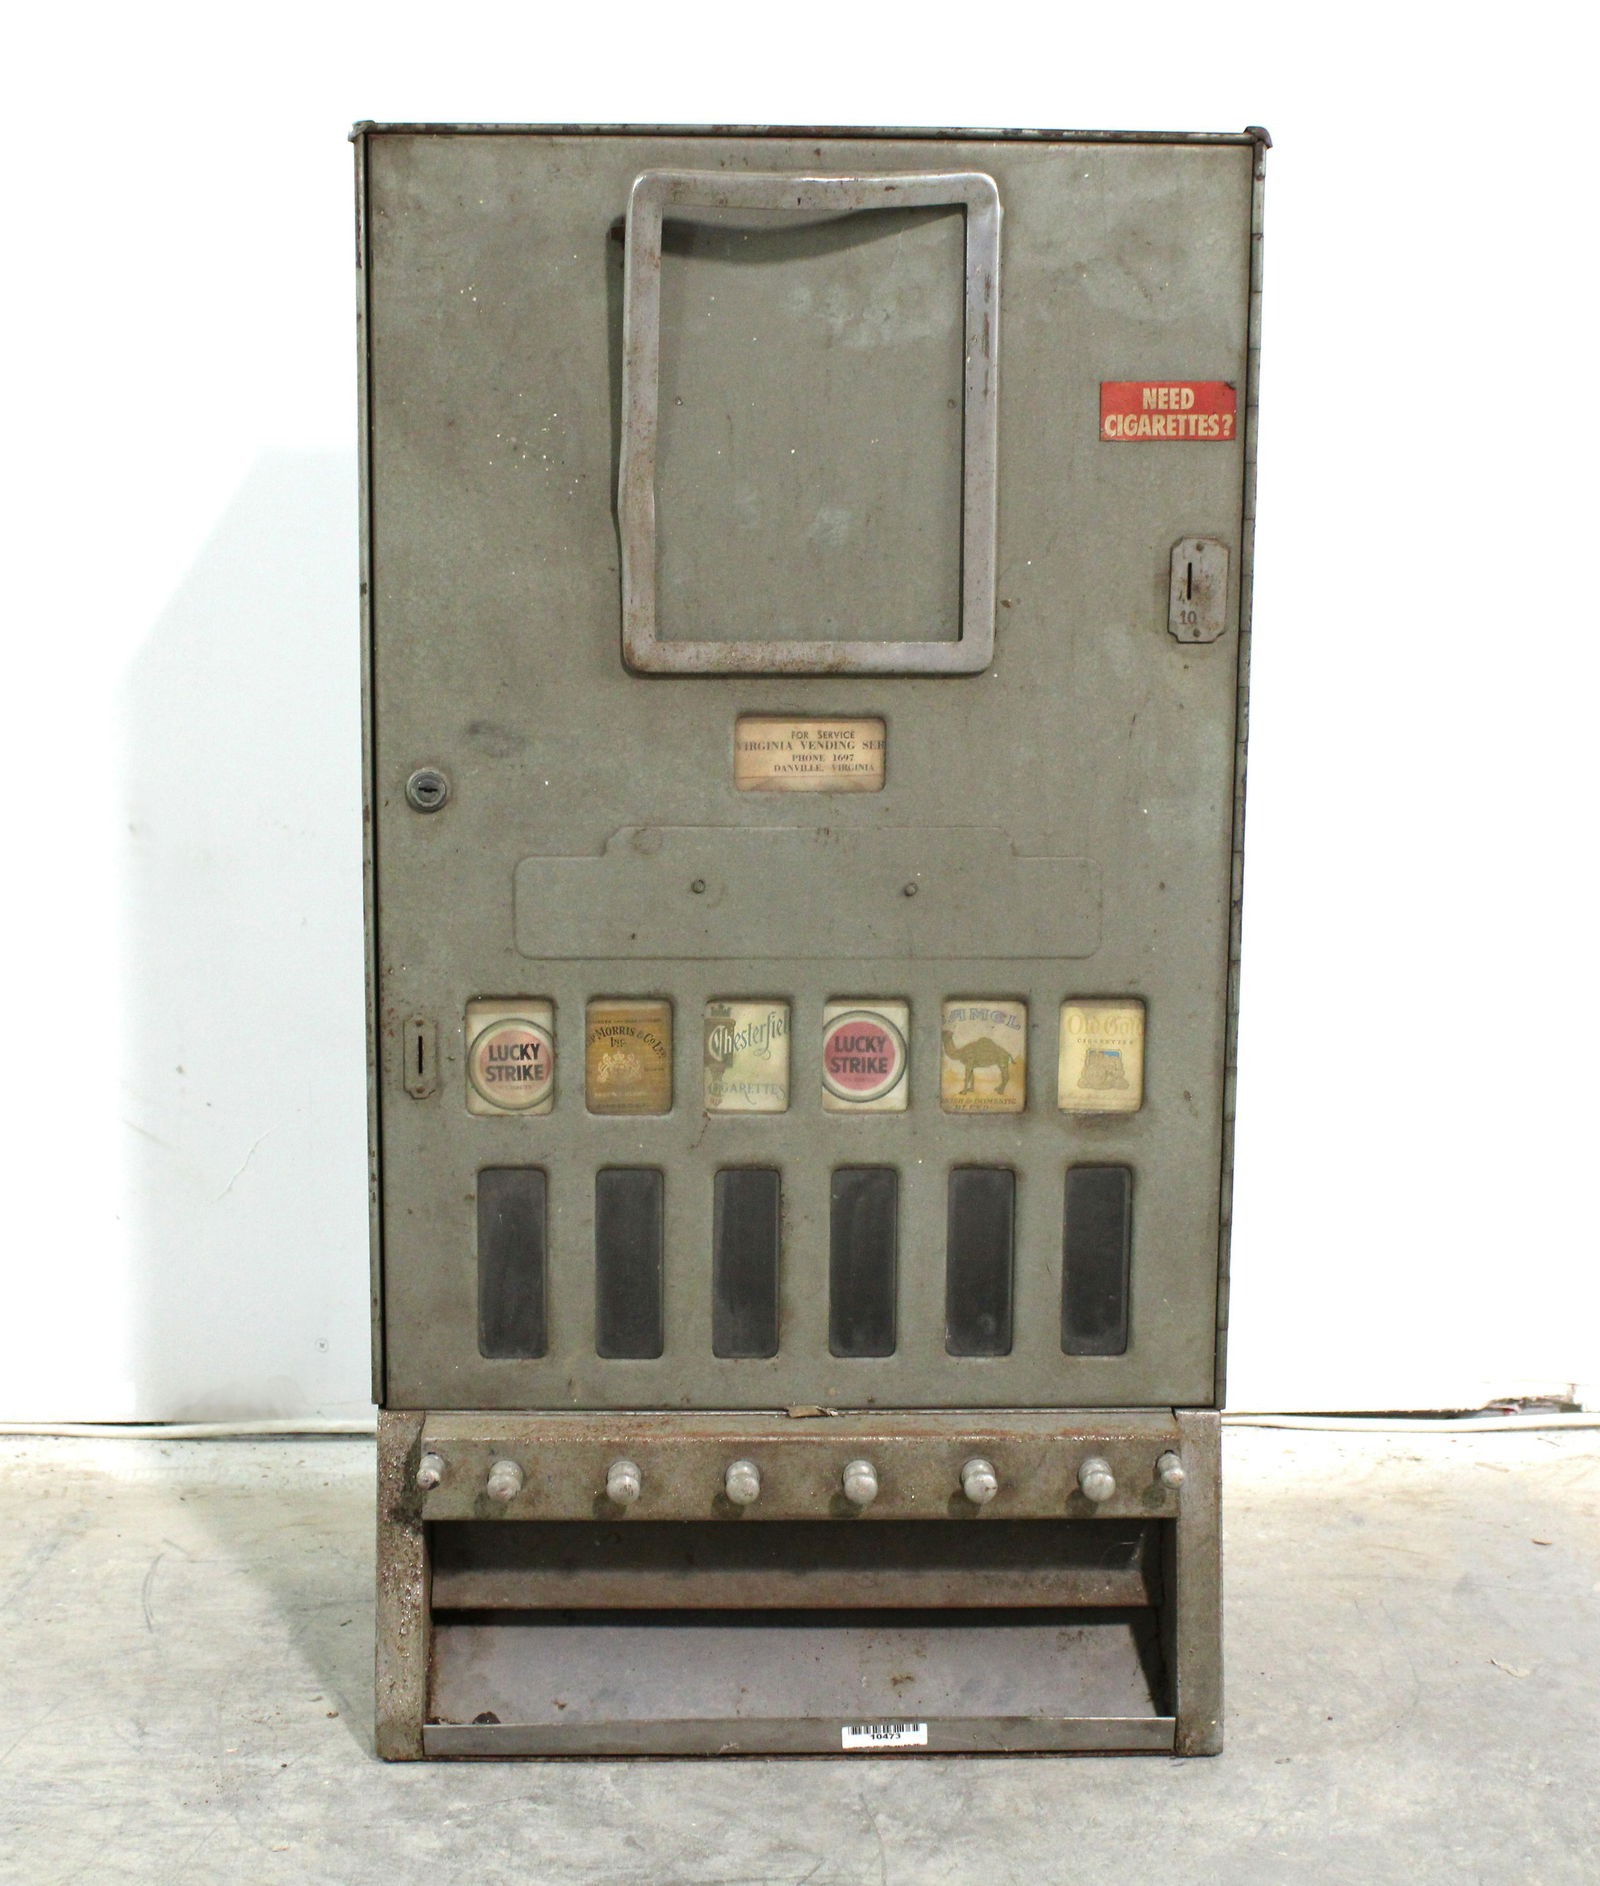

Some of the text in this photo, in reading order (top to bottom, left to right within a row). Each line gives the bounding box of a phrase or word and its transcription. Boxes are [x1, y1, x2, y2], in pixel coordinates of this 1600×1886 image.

[1142, 387, 1195, 410] NEED
[1104, 413, 1234, 437] CIGARETTES?
[1179, 610, 1198, 625] 10
[791, 730, 855, 740] FOR SERVICE
[800, 740, 855, 751] VENDING
[792, 753, 854, 763] PHONE 1697
[832, 763, 875, 772] VIRGINIA
[594, 1026, 636, 1041] MORRIS
[834, 1035, 886, 1053] LUCKY
[488, 1043, 540, 1062] LUCKY
[830, 1056, 889, 1074] STRIKE
[485, 1064, 544, 1082] STRIKE
[870, 1732, 901, 1741] 10473
